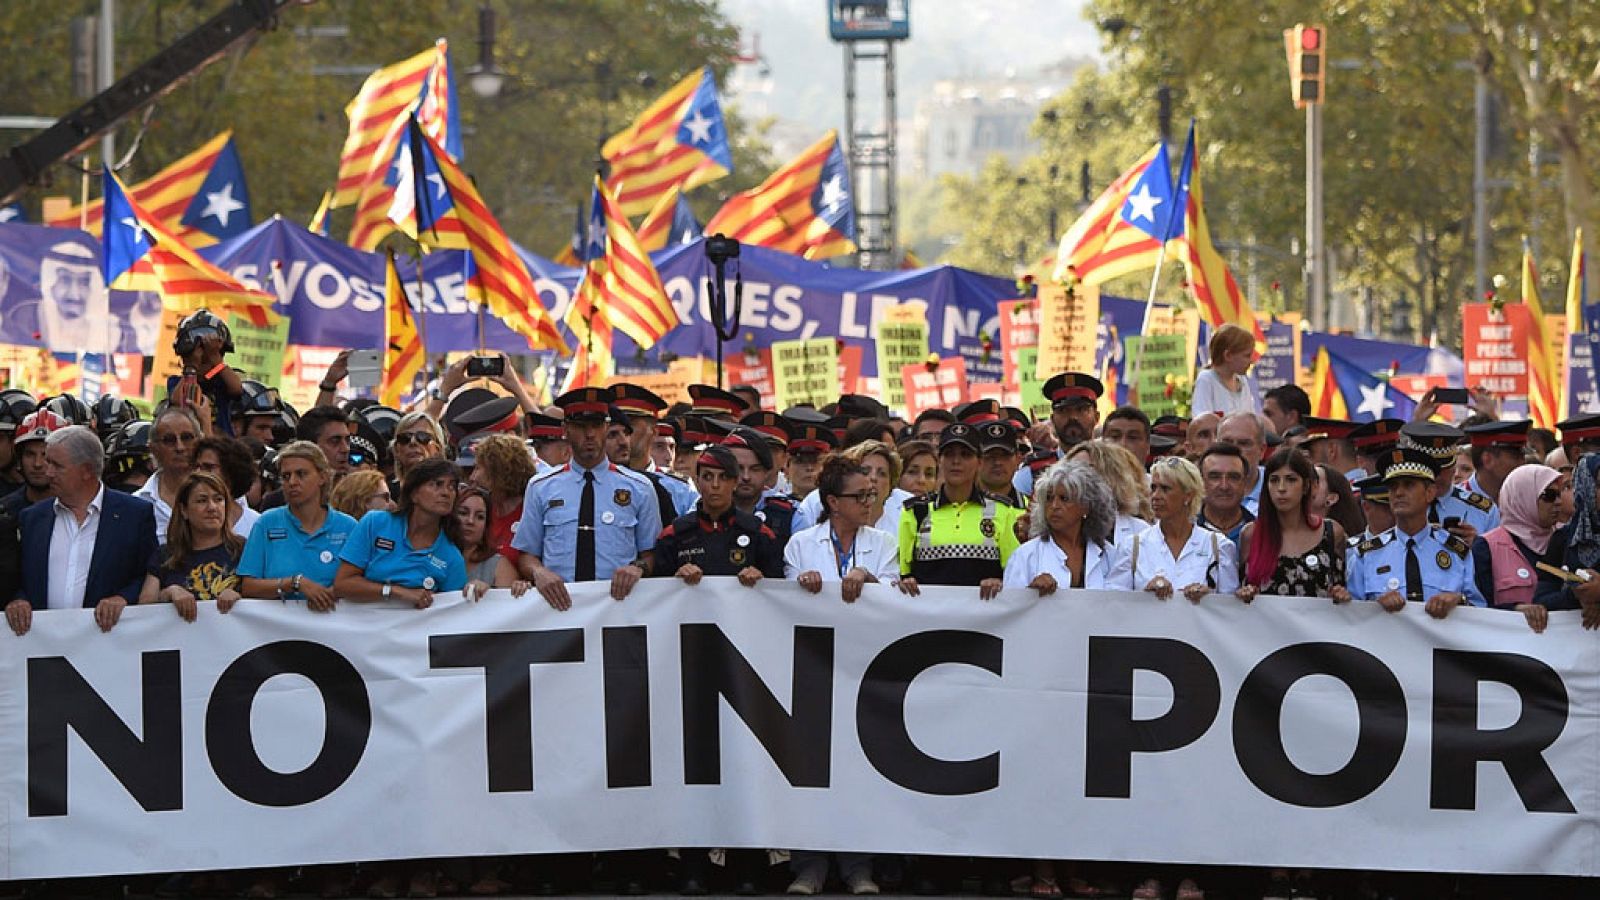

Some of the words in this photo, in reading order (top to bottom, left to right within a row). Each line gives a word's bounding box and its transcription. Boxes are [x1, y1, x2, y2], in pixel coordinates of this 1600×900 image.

[26, 640, 371, 818] NO
[428, 622, 1004, 796] TINC
[1085, 624, 1577, 815] POR
